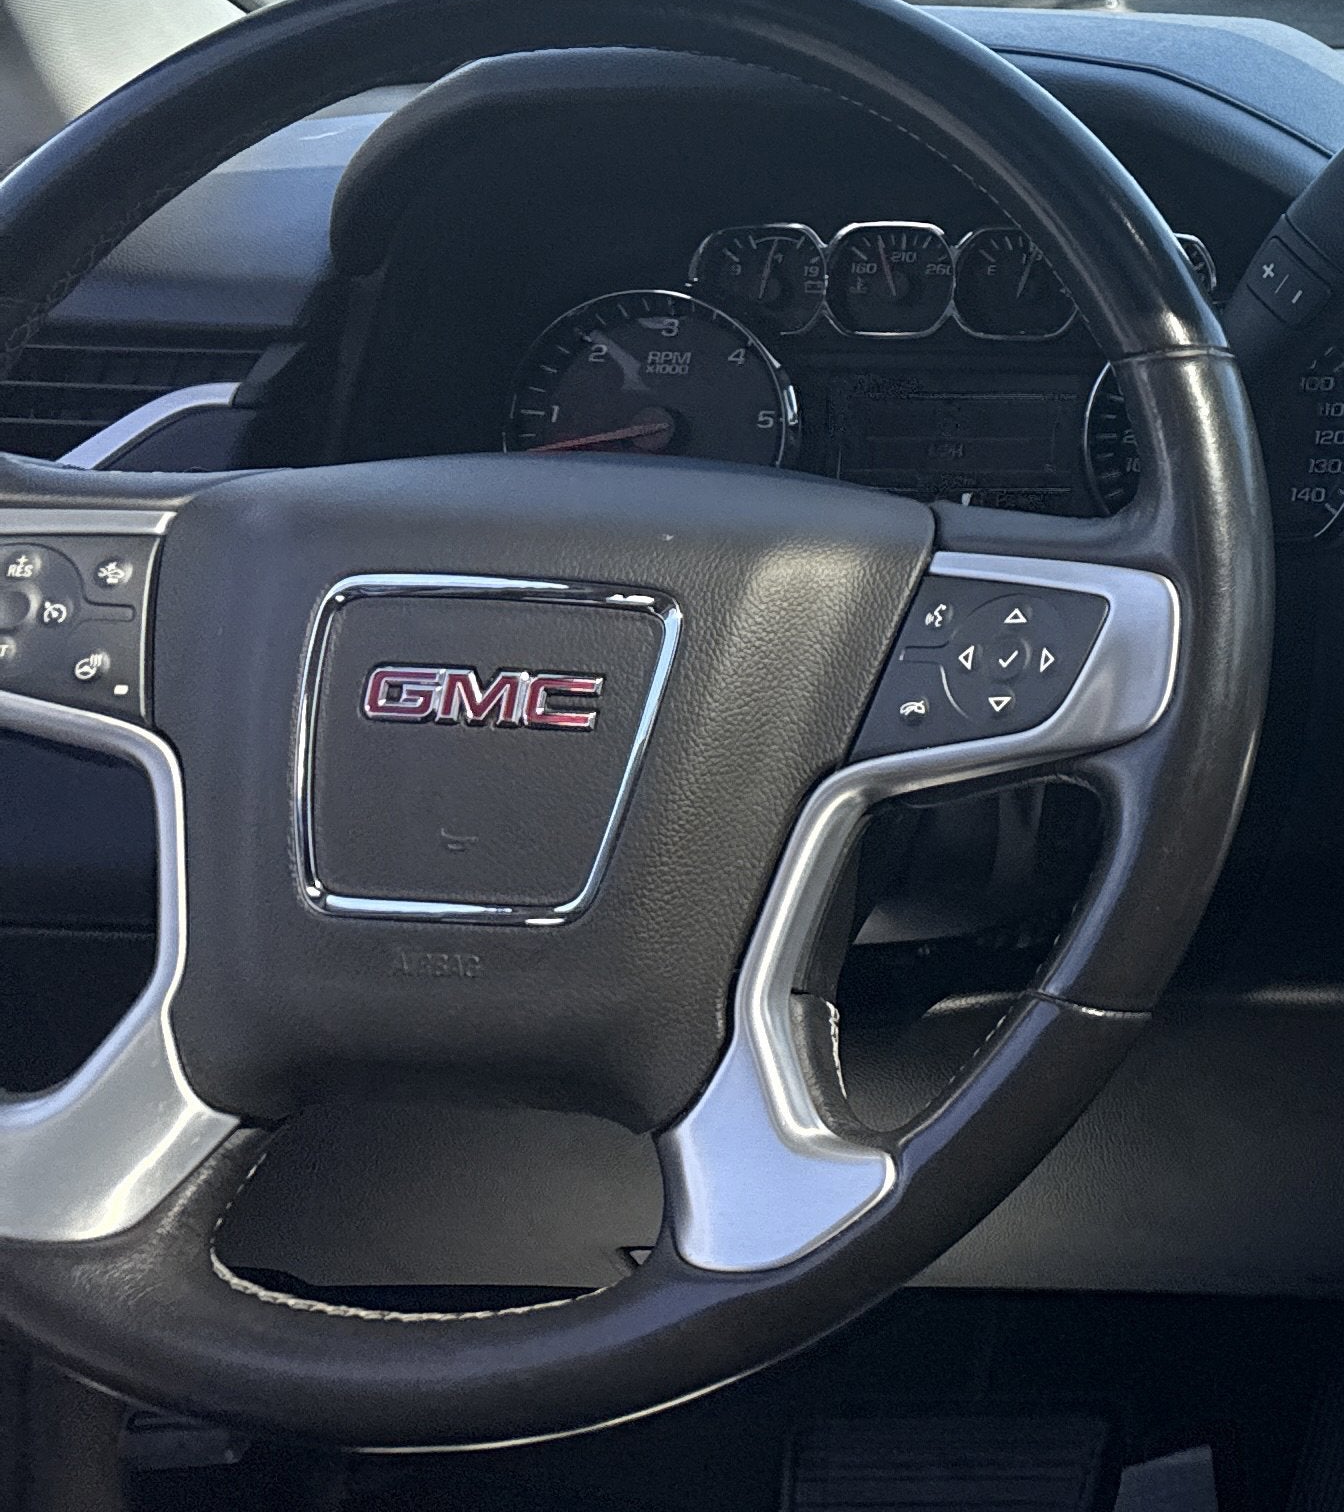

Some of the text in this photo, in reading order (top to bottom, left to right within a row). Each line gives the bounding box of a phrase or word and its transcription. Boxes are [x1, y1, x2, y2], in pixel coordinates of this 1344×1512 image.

[891, 251, 916, 263] 210
[803, 266, 819, 277] 19
[661, 319, 679, 337] 3
[588, 345, 607, 362] 2
[647, 352, 692, 364] RPM
[728, 349, 745, 364] 4
[552, 406, 559, 422] 1
[757, 411, 774, 429] 5
[1309, 458, 1342, 473] 130
[1292, 488, 1326, 504] 140
[6, 564, 33, 578] RES
[363, 668, 604, 730] GMC
